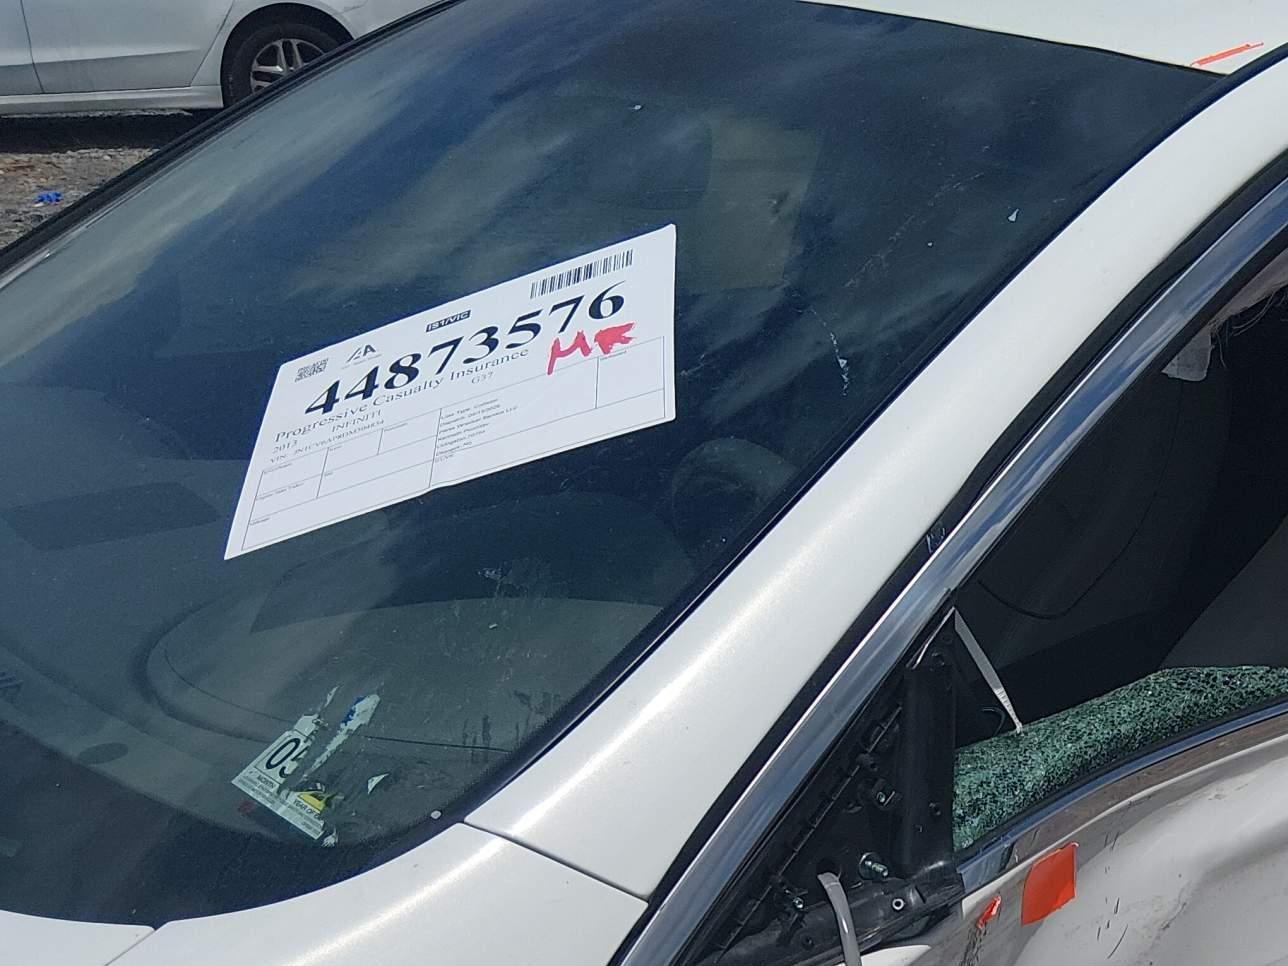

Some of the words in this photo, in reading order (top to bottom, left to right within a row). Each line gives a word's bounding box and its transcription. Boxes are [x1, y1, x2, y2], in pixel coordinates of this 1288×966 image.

[304, 280, 626, 415] 44873576
[271, 439, 298, 454] 2013
[332, 409, 382, 432] INFINITI
[275, 404, 368, 442] Progressive
[373, 378, 443, 407] Casualty
[450, 349, 529, 381] Insurance
